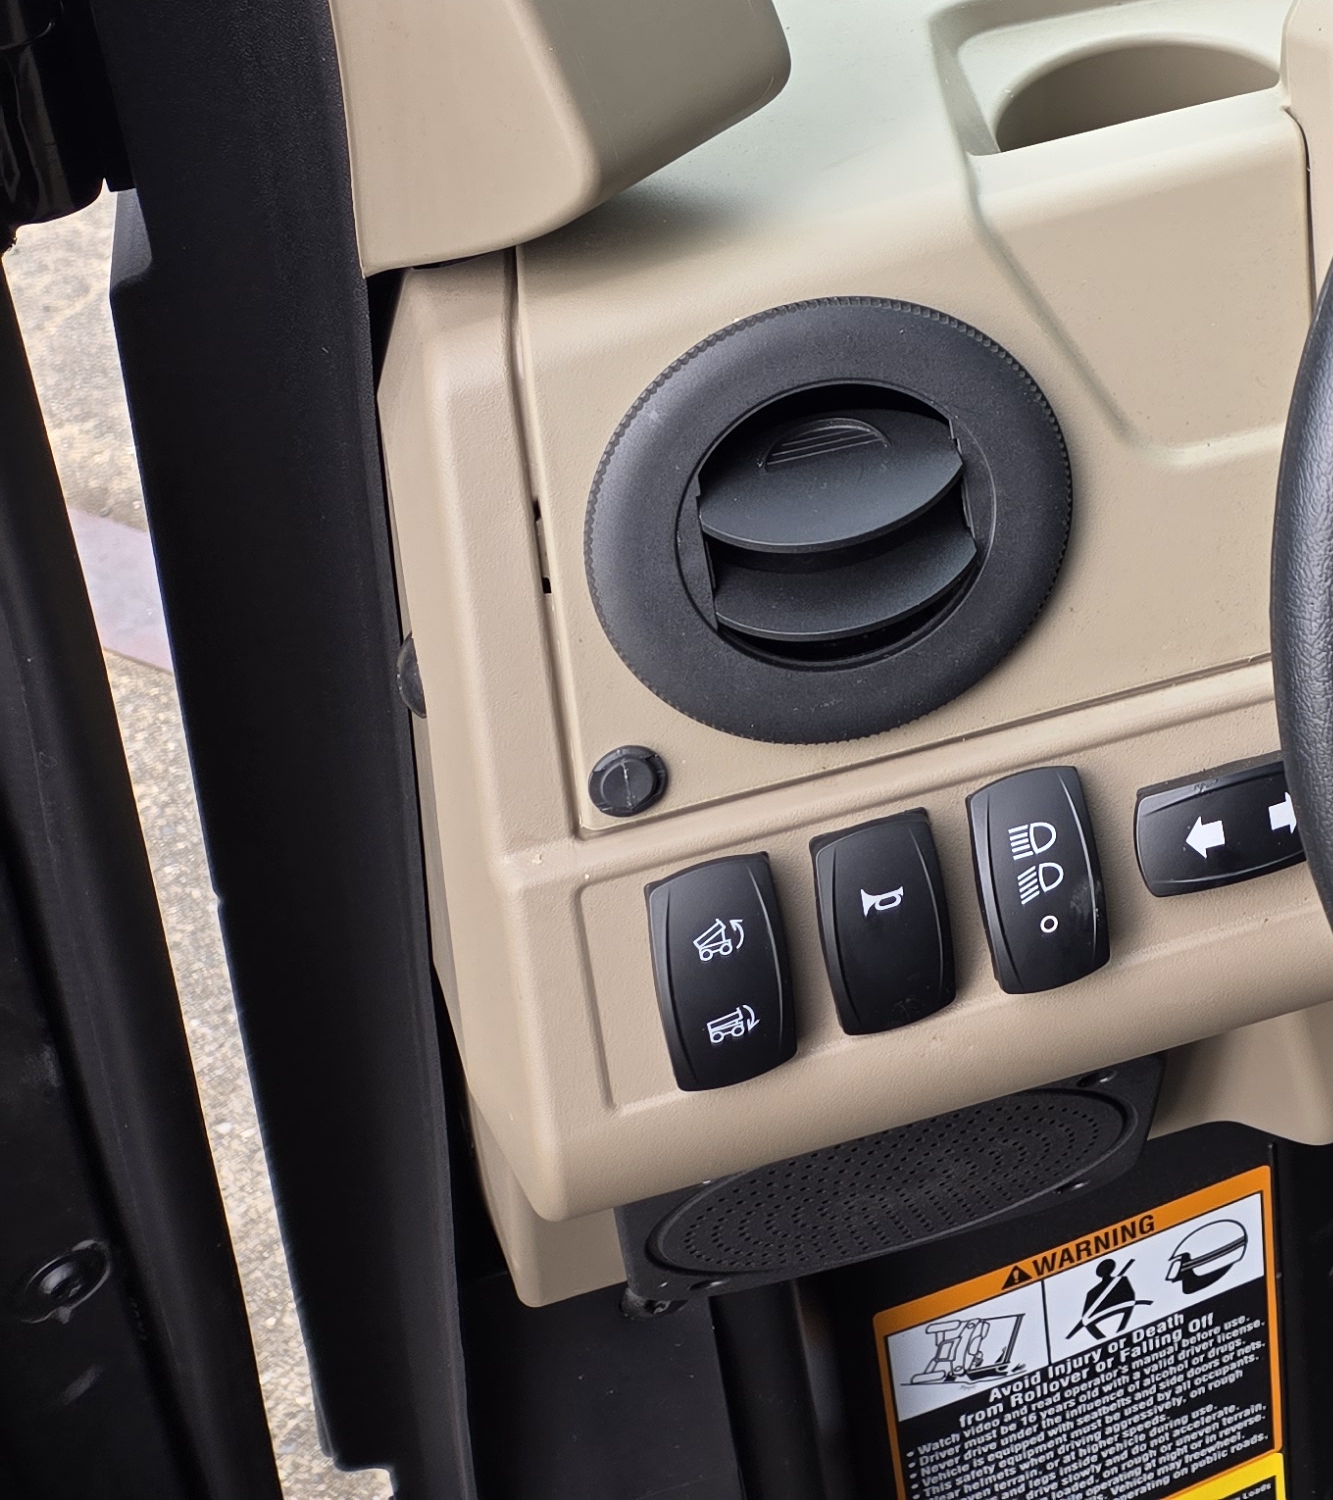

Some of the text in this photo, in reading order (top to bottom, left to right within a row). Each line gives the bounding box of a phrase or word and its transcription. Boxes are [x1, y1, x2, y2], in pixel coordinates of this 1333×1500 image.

[1032, 1213, 1156, 1277] WARNING
[918, 1316, 1249, 1454] Watch video and read operator's manual before use.
[920, 1320, 1264, 1466] Driver must be 16 years old with a valid driver license.
[960, 1312, 1213, 1428] from Rollover or Falling Off
[988, 1314, 1184, 1402] Avoid Injury or Death
[920, 1338, 1245, 1476] Never drive under the influence of alcohol or drugs.
[922, 1340, 1265, 1486] Vehicle is equipped with seatbelts and side doors or nets.
[924, 1480, 952, 1496] This
[956, 1464, 995, 1486] safety
[998, 1434, 1068, 1468] equipment
[1070, 1418, 1102, 1438] must
[1104, 1412, 1120, 1424] be
[1124, 1396, 1153, 1416] used
[1156, 1390, 1172, 1402] by
[1174, 1380, 1190, 1394] all
[1194, 1354, 1259, 1386] occupants.
[964, 1466, 1016, 1494] helmets
[1019, 1450, 1054, 1470] when
[1058, 1430, 1102, 1454] driving
[1190, 1386, 1205, 1398] on
[1208, 1370, 1243, 1390] rough
[1002, 1483, 1026, 1500] and
[1028, 1472, 1056, 1488] legs
[1060, 1454, 1098, 1476] inside
[1100, 1434, 1146, 1458] vehicle
[1148, 1414, 1188, 1438] during
[1192, 1404, 1217, 1418] use.
[1026, 1482, 1058, 1500] drive
[1061, 1462, 1102, 1486] slowly
[1104, 1450, 1128, 1466] and
[1132, 1442, 1146, 1456] do
[1150, 1432, 1169, 1448] not
[1172, 1404, 1239, 1438] accelerate.
[1046, 1458, 1060, 1470] or
[1062, 1450, 1076, 1464] at
[1078, 1434, 1120, 1459] higher
[1122, 1414, 1170, 1438] speeds.
[1102, 1466, 1118, 1478] on
[1120, 1450, 1156, 1470] rough
[1160, 1442, 1173, 1454] or
[1176, 1422, 1219, 1446] uneven
[1086, 1466, 1142, 1498] operating
[1144, 1458, 1156, 1471] at
[1158, 1444, 1188, 1464] night
[1190, 1440, 1203, 1450] or
[1205, 1434, 1216, 1444] in
[1218, 1414, 1265, 1438] reverse.
[1110, 1472, 1154, 1496] Vehicle
[1156, 1458, 1182, 1476] may
[1184, 1432, 1245, 1464] freewheel.
[1172, 1468, 1188, 1480] on
[1190, 1450, 1228, 1473] public
[1230, 1432, 1268, 1454] roads.
